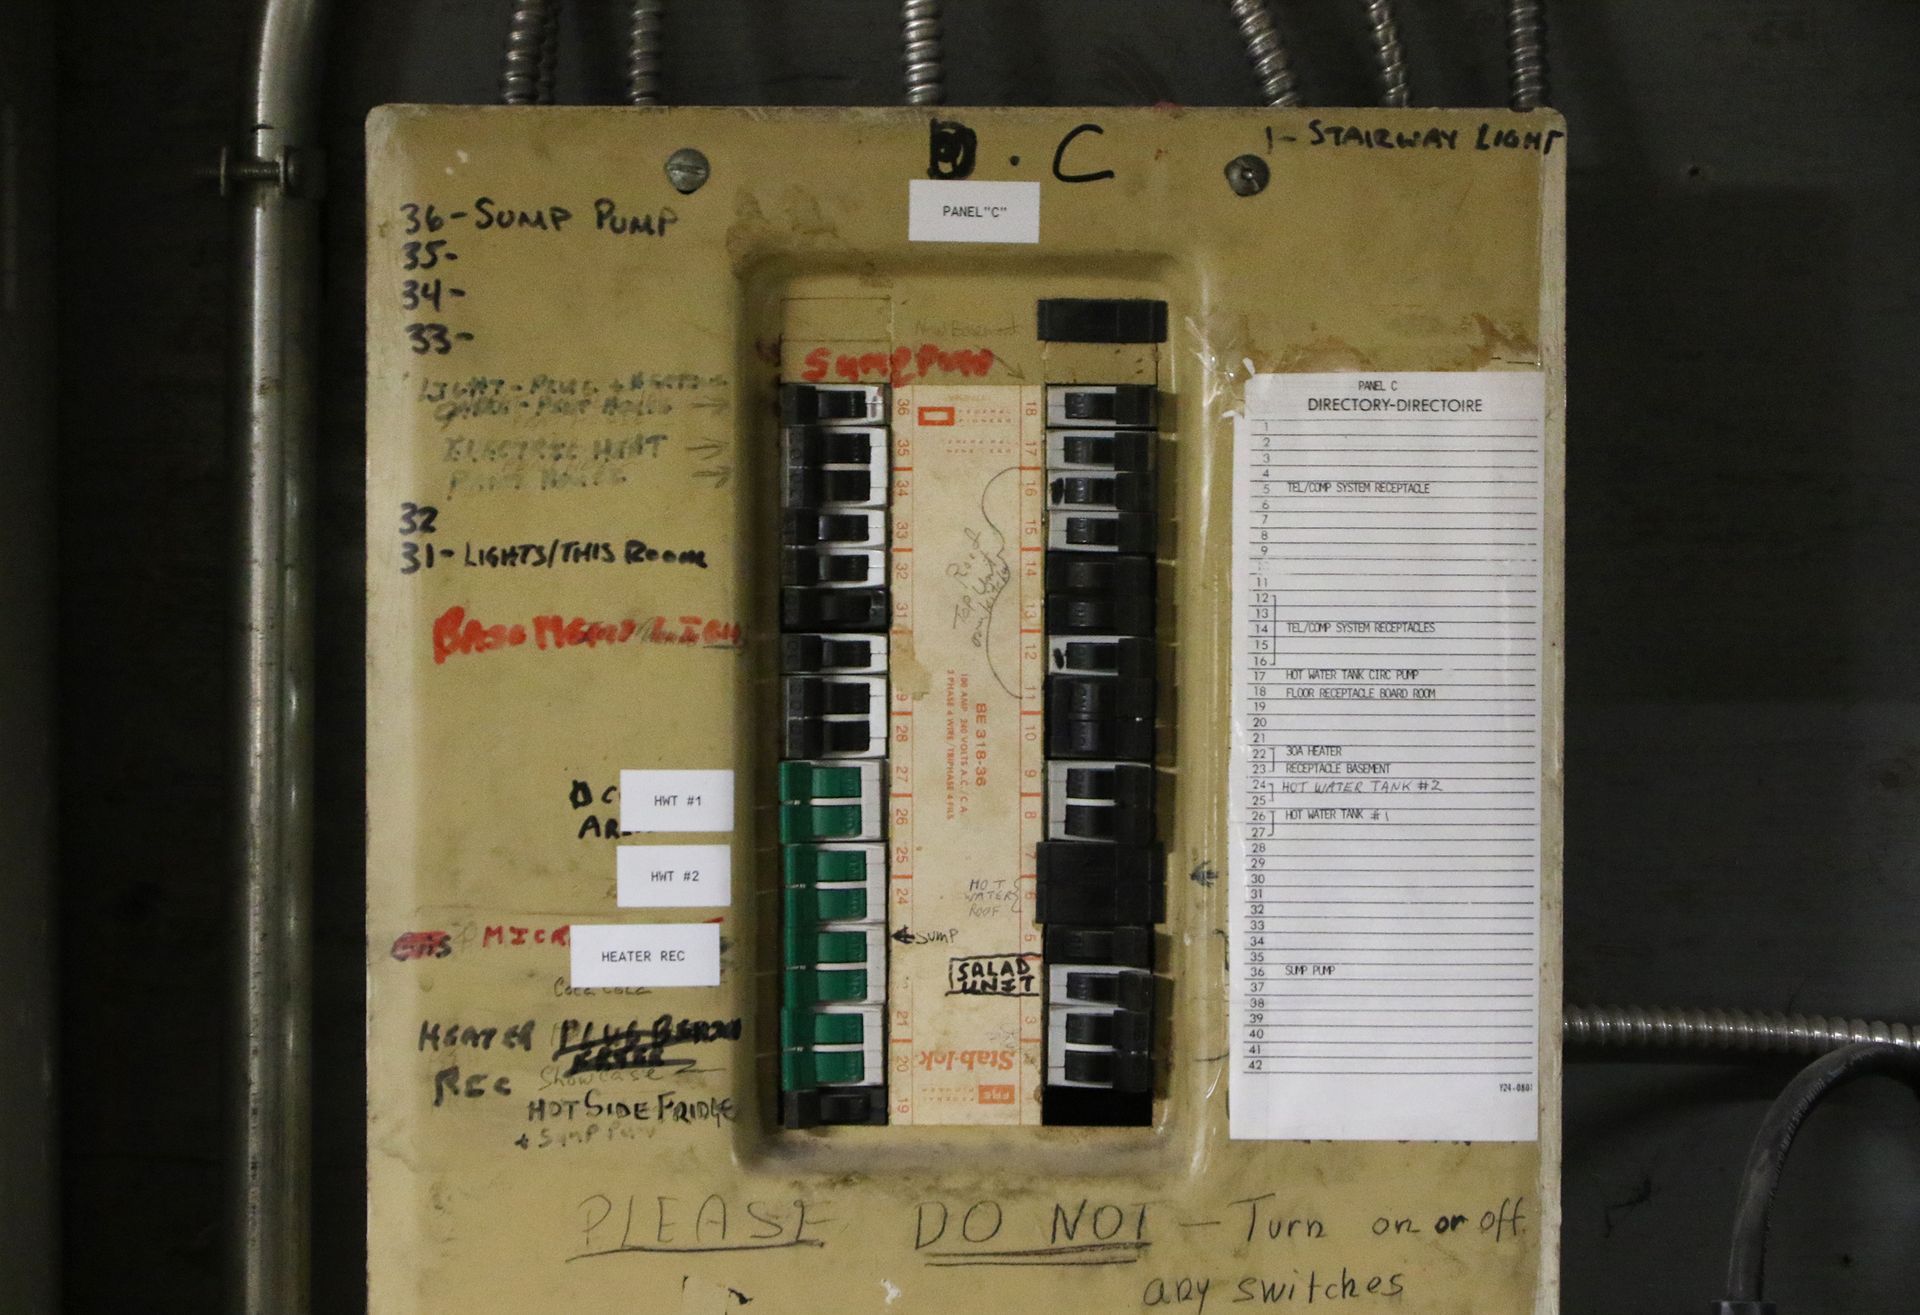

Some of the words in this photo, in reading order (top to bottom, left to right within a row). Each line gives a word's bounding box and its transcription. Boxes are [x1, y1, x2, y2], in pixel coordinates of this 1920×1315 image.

[1308, 119, 1458, 150] STAIRWAY
[1475, 123, 1565, 155] LIGHT
[1358, 380, 1386, 391] PANEL
[1391, 380, 1398, 391] C
[897, 398, 909, 416] 36
[1025, 402, 1037, 416] 18
[1307, 397, 1483, 412] DIRECTORY-DIRECTOIRE
[897, 439, 909, 457] 35
[1263, 437, 1270, 447] 2
[1025, 442, 1037, 457] 17
[1263, 453, 1270, 463] 3
[1262, 469, 1270, 478] 4
[896, 479, 909, 497] 34
[1025, 481, 1037, 497] 16
[1262, 484, 1270, 494] 5
[1336, 482, 1370, 493] SYSTEM
[1374, 483, 1430, 494] RECEPTACLE
[1262, 500, 1270, 510] 6
[1262, 515, 1268, 525] 7
[896, 521, 909, 540] 33
[1025, 519, 1037, 536] 15
[1261, 531, 1268, 541] 8
[1261, 546, 1268, 556] 9
[896, 562, 909, 580] 32
[1025, 561, 1037, 577] 14
[1256, 578, 1268, 587] 11
[1256, 593, 1268, 603] 12
[896, 602, 909, 619] 31
[1256, 609, 1268, 619] 13
[1255, 624, 1268, 633] 14
[1336, 622, 1370, 633] SYSTEM
[1374, 622, 1435, 633] RECEPTACLES
[1255, 640, 1268, 650] 15
[1025, 644, 1037, 660] 12
[1253, 656, 1267, 666] 16
[1253, 671, 1266, 681] 17
[1286, 669, 1303, 680] HOT
[1308, 669, 1336, 680] WATER
[1342, 670, 1364, 680] TANK
[1369, 670, 1392, 680] CIRC
[1397, 670, 1419, 680] PUMP
[1253, 686, 1266, 696] 18
[1286, 688, 1314, 699] FLOOR
[1319, 688, 1374, 699] RECEPTACLE
[1379, 688, 1408, 699] BOARD
[1413, 688, 1436, 699] ROOM
[1253, 702, 1266, 711] 19
[975, 703, 988, 725] BE
[1253, 718, 1267, 727] 20
[896, 725, 909, 743] 28
[1025, 726, 1037, 742] 10
[1253, 733, 1266, 743] 21
[1253, 749, 1267, 759] 22
[1308, 745, 1342, 756] HEATER
[896, 766, 909, 783] 27
[1252, 764, 1266, 774] 23
[1286, 763, 1341, 774] RECEPTACLE
[1346, 763, 1391, 774] BASEMENT
[1252, 779, 1266, 789] 24
[1282, 782, 1305, 793] HOT
[1315, 782, 1363, 793] WATER
[1371, 781, 1411, 793] TANK
[653, 795, 679, 807] HWT
[1252, 795, 1266, 806] 25
[896, 808, 909, 825] 26
[1252, 811, 1266, 821] 26
[1285, 809, 1303, 819] HOT
[1308, 809, 1336, 819] WATER
[1341, 809, 1364, 820] TANK
[1251, 827, 1265, 837] 27
[1251, 843, 1266, 853] 28
[896, 847, 909, 864] 25
[1251, 858, 1265, 868] 29
[650, 870, 675, 882] HWT
[683, 870, 700, 882] #2
[1251, 874, 1265, 884] 30
[1250, 889, 1262, 899] 31
[1250, 904, 1264, 914] 32
[1250, 920, 1264, 930] 33
[1250, 936, 1264, 946] 34
[601, 950, 652, 963] HEATER
[660, 950, 686, 962] REC
[1250, 952, 1264, 962] 35
[957, 957, 1031, 982] SALAD
[1250, 967, 1264, 977] 36
[1285, 964, 1308, 976] SUMP
[1312, 964, 1336, 976] PUMP
[961, 974, 1035, 994] UNIT
[1250, 982, 1264, 992] 37
[1250, 998, 1264, 1008] 38
[1249, 1014, 1263, 1023] 39
[1249, 1029, 1263, 1039] 40
[1248, 1045, 1261, 1054] 41
[1248, 1060, 1262, 1070] 42
[528, 1098, 582, 1122] HOT
[584, 1088, 650, 1121] SIDE
[577, 1194, 839, 1248] PLEASE
[913, 1199, 1003, 1250] DO
[1050, 1198, 1152, 1244] NOT
[1228, 1192, 1329, 1242] Turn
[1372, 1214, 1420, 1237] on
[1433, 1213, 1469, 1235] or
[1232, 1268, 1405, 1304] switches
